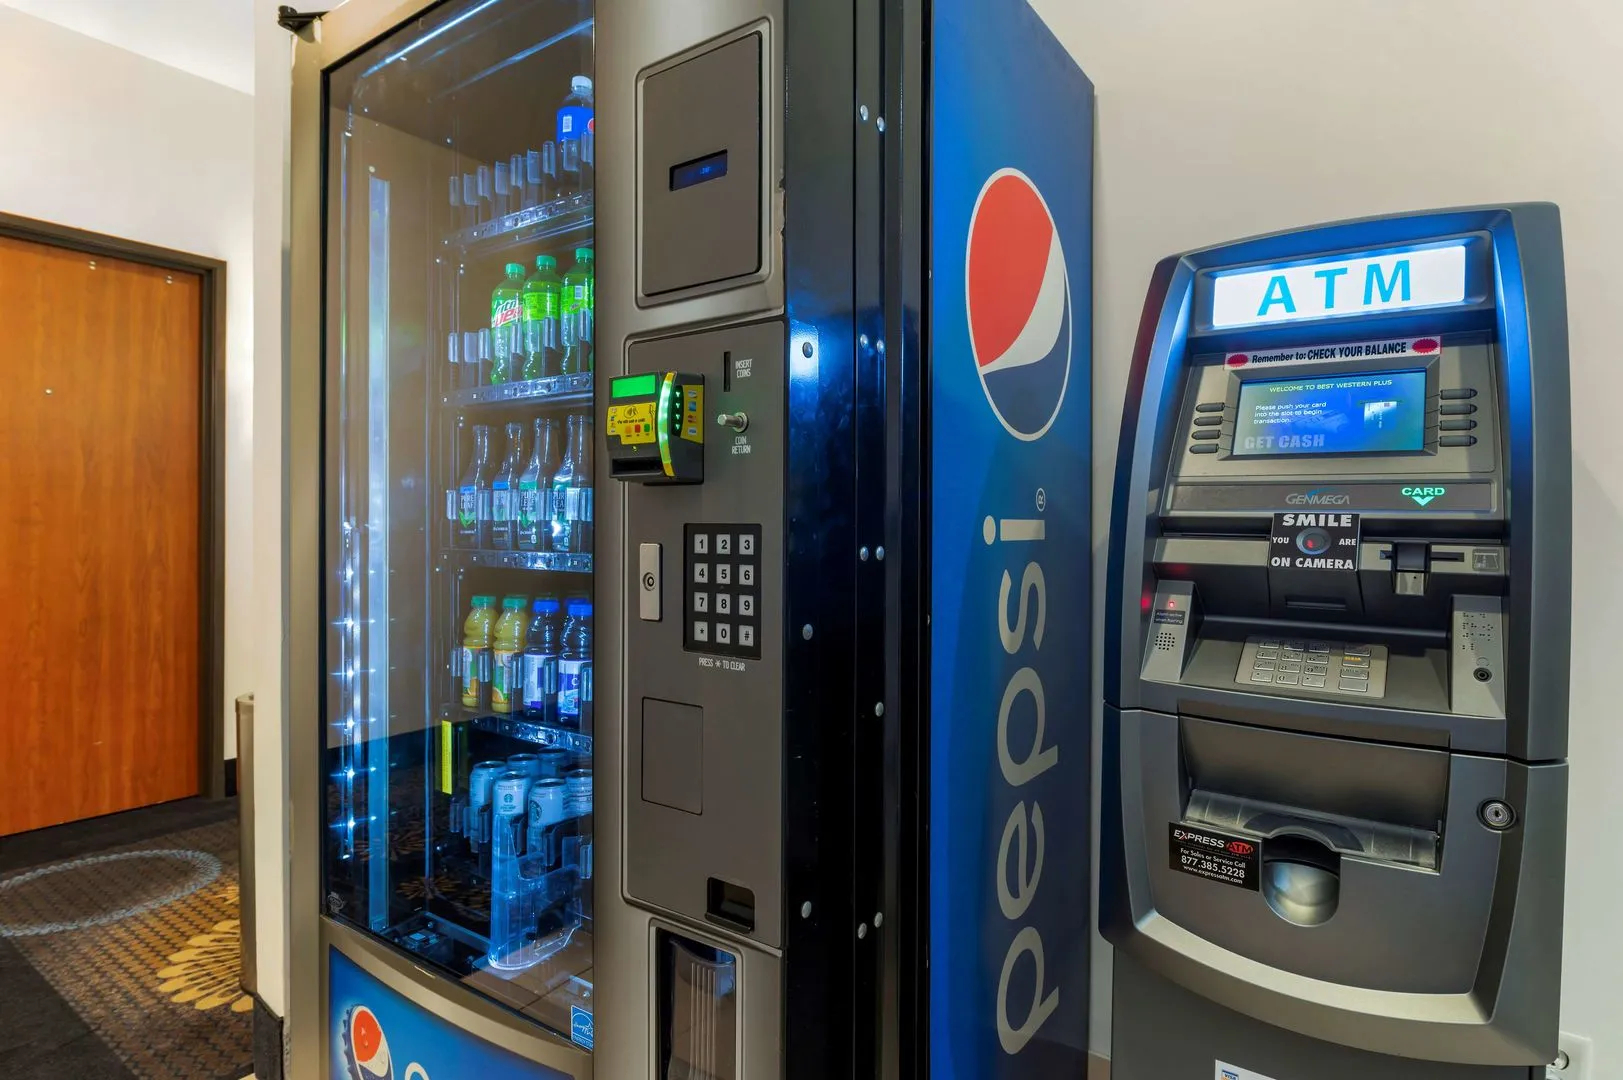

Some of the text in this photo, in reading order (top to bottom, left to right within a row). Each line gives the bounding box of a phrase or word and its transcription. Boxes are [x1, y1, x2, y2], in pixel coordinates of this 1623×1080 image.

[1257, 259, 1412, 316] ATM
[1252, 341, 1407, 364] Remember to: CHECK YOUR BALANCE
[735, 358, 753, 370] INSERT
[736, 368, 752, 379] COINS
[1269, 385, 1303, 393] WELCOME
[1336, 380, 1372, 389] WESTERN
[1373, 379, 1393, 387] PLUS
[1277, 403, 1293, 411] push
[1311, 401, 1327, 409] card
[1303, 408, 1323, 417] begin
[1253, 417, 1292, 425] transaction.
[735, 435, 747, 445] COIN
[1244, 434, 1326, 449] GET CASH
[731, 444, 752, 455] RETURN
[1401, 487, 1446, 496] CARD
[1285, 493, 1350, 505] GENMEGA
[1282, 514, 1352, 527] SMILE
[699, 539, 750, 550] 1 2 3
[1272, 536, 1357, 546] YOU ARE
[1271, 557, 1354, 570] ON CAMERA
[699, 568, 750, 580] 4 5 6
[699, 597, 750, 611] 7 8 9
[721, 628, 727, 639] 0
[699, 657, 746, 672] PRESS TO CLEAR
[983, 515, 1059, 1055] pepsi
[1173, 829, 1225, 848] EXPRESS
[1227, 841, 1254, 854] ATM
[1190, 849, 1205, 859] Sales
[1213, 855, 1233, 866] Service
[1234, 860, 1246, 869] Call
[1181, 855, 1245, 878] 877.385.5228
[1183, 865, 1243, 884] www.expressatm.com
